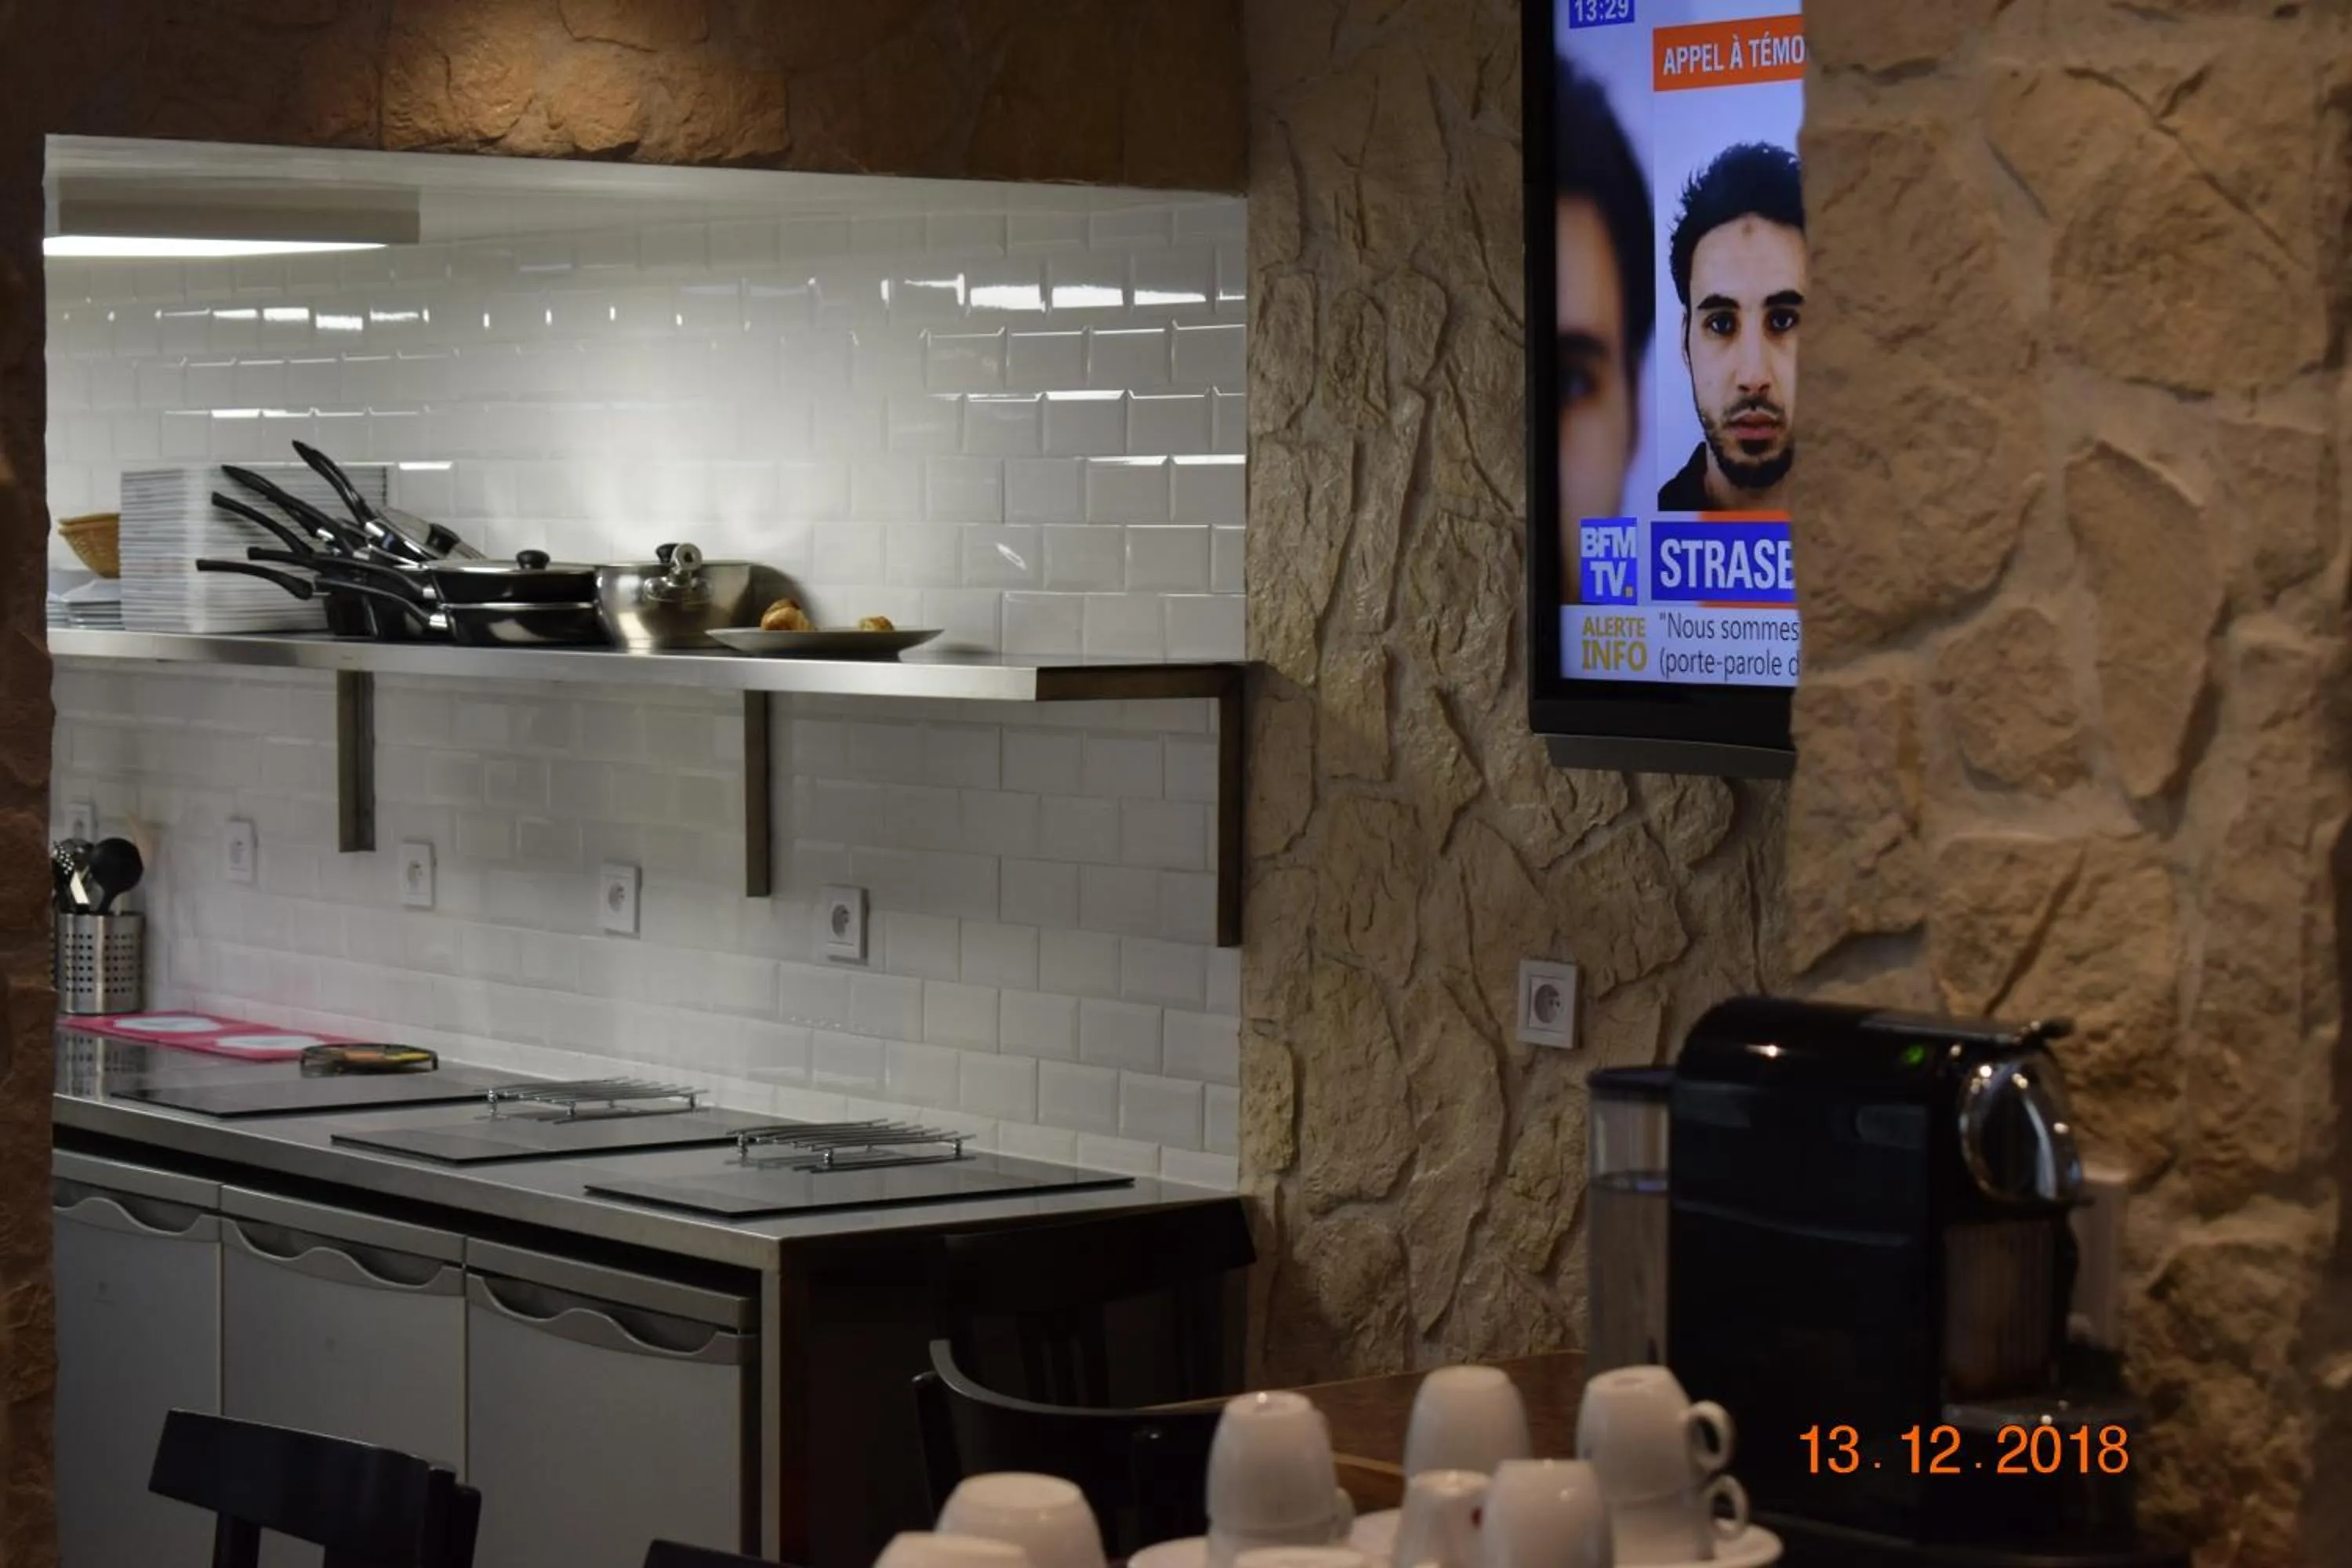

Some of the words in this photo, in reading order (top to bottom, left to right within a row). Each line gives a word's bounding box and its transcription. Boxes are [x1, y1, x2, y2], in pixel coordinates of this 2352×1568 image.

[1575, 0, 1629, 22] 13:29
[1662, 42, 1724, 76] APPEL
[1730, 34, 1744, 70] À
[1581, 526, 1637, 559] BFM
[1582, 616, 1646, 637] ALERTE
[1659, 612, 1715, 641] "Nous
[1720, 620, 1800, 641] sommes
[1581, 640, 1648, 672] INFO
[1659, 647, 1782, 681] (porte-parole
